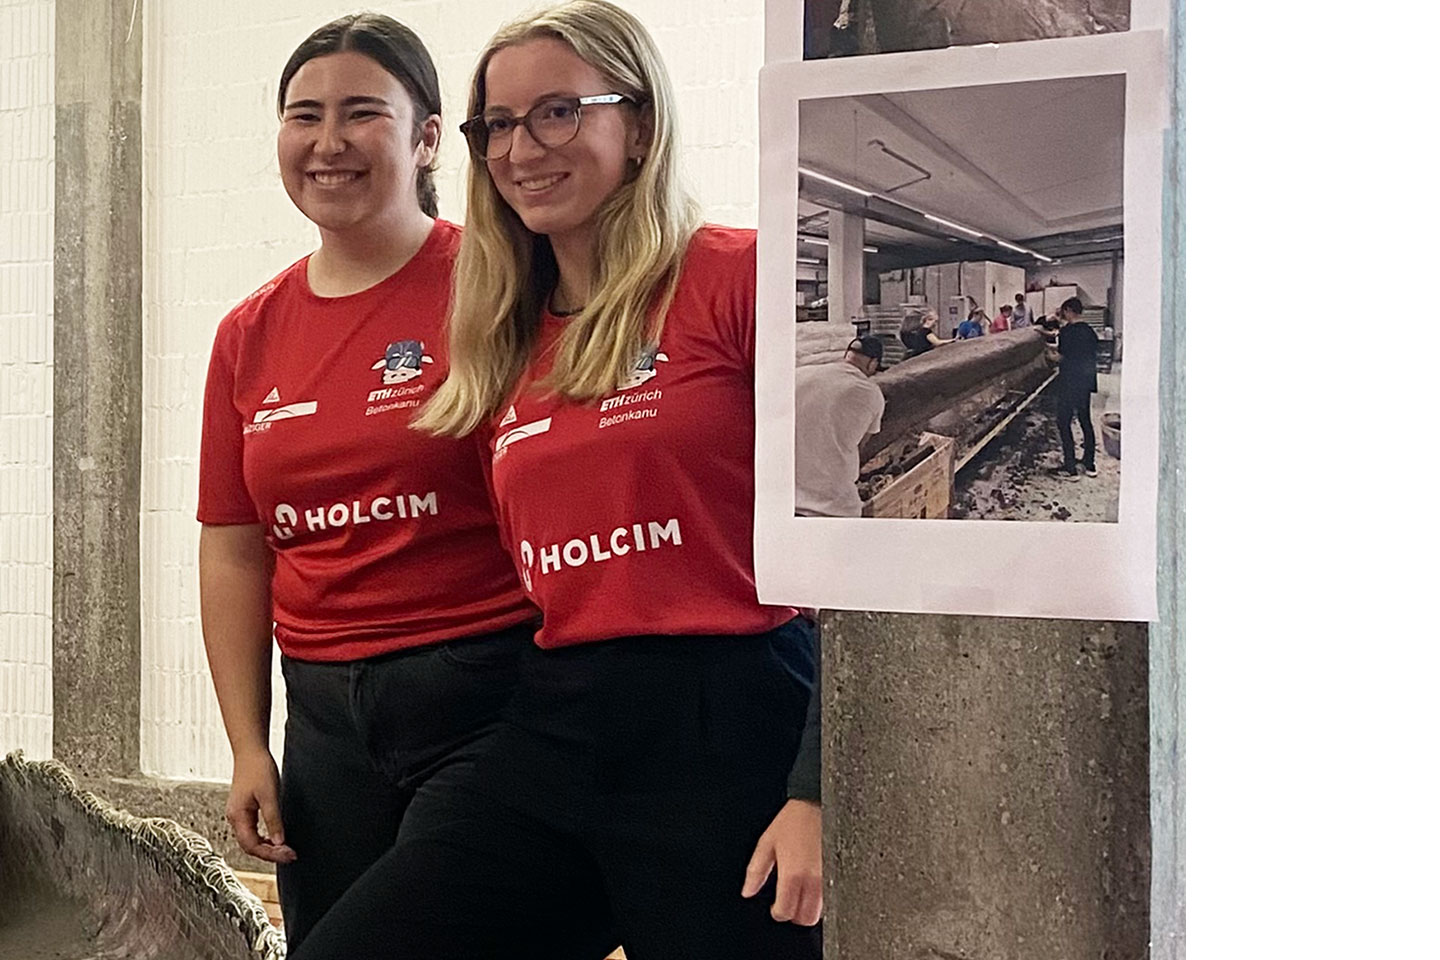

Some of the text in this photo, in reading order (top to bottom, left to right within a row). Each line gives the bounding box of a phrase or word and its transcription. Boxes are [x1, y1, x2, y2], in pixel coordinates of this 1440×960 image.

[598, 407, 658, 429] Betonkanu
[304, 491, 439, 532] HOLCIM
[540, 517, 683, 575] HOLCIM
